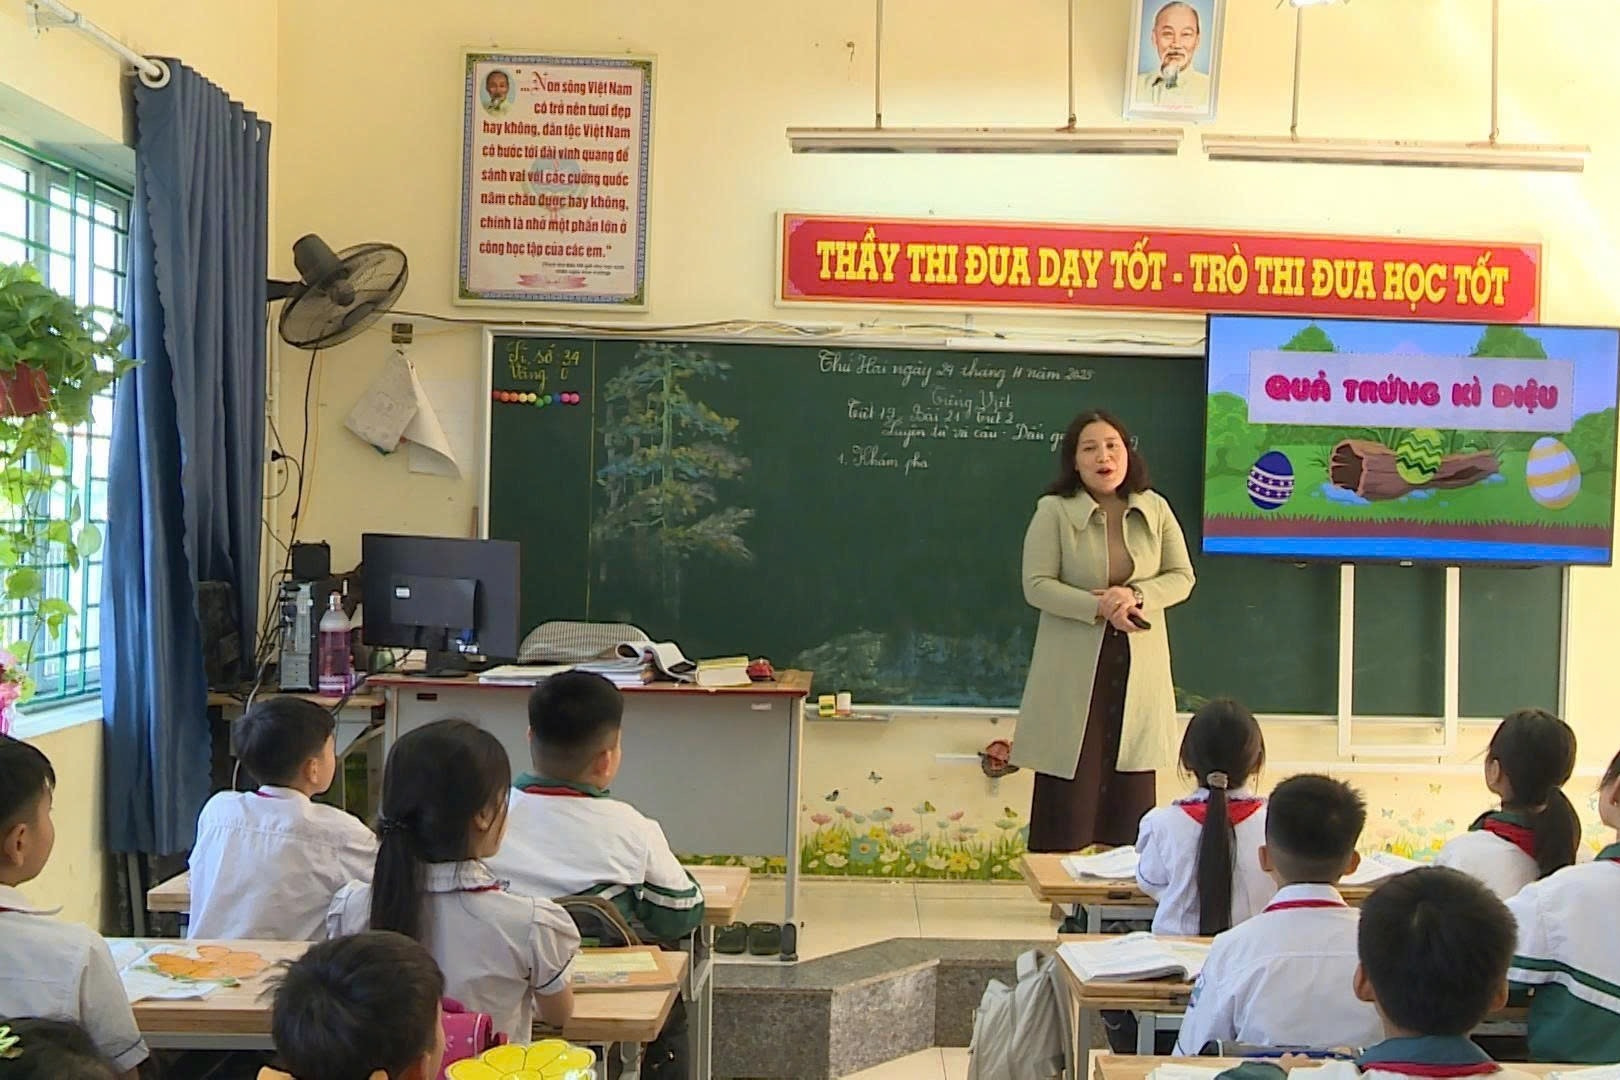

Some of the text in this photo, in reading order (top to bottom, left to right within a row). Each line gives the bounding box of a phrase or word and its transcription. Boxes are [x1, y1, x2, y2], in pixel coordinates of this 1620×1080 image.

[562, 79, 586, 96] sông
[588, 81, 607, 98] Việt
[609, 82, 633, 96] Nam
[534, 100, 631, 119] có trở nên tươi đẹp
[483, 120, 503, 136] hay
[542, 121, 562, 136] dân
[564, 123, 581, 139] tộc
[583, 124, 604, 141] Việt
[605, 125, 631, 139] Nam
[482, 144, 630, 164] có bước tới đài vinh quang để
[481, 168, 629, 187] sánh vai với các cường quốc
[508, 192, 536, 206] châu
[538, 192, 567, 208] được
[568, 194, 589, 210] hay
[480, 215, 511, 230] chính
[513, 216, 524, 230] là
[525, 215, 546, 231] nhờ
[548, 218, 569, 234] một
[571, 216, 599, 234] phần
[600, 217, 619, 234] lớn
[479, 240, 504, 256] công
[506, 241, 525, 258] học
[527, 241, 543, 258] tập
[544, 241, 564, 256] của
[565, 242, 585, 257] các
[816, 227, 900, 282] THẦY
[907, 244, 959, 284] THI
[965, 245, 1031, 286] ĐUA
[1038, 247, 1103, 298] DẠY
[1110, 236, 1167, 291] TỐT
[1190, 242, 1249, 294] TRÒ
[1255, 256, 1305, 297] THI
[1312, 259, 1376, 299] ĐUA
[1383, 261, 1447, 311] HỌC
[1454, 251, 1509, 305] TỐT
[855, 354, 886, 374] Hai
[891, 360, 933, 387] ngày
[959, 357, 1006, 388] tháng
[1026, 366, 1061, 381] năm
[931, 385, 1010, 419] Tiếng Việt
[1265, 370, 1558, 414] QUẢ TRỨNG KÌ DIỆU
[881, 417, 926, 448] Luyện
[973, 425, 997, 438] câu
[1012, 423, 1045, 441] Dấu
[852, 445, 899, 468] Khám
